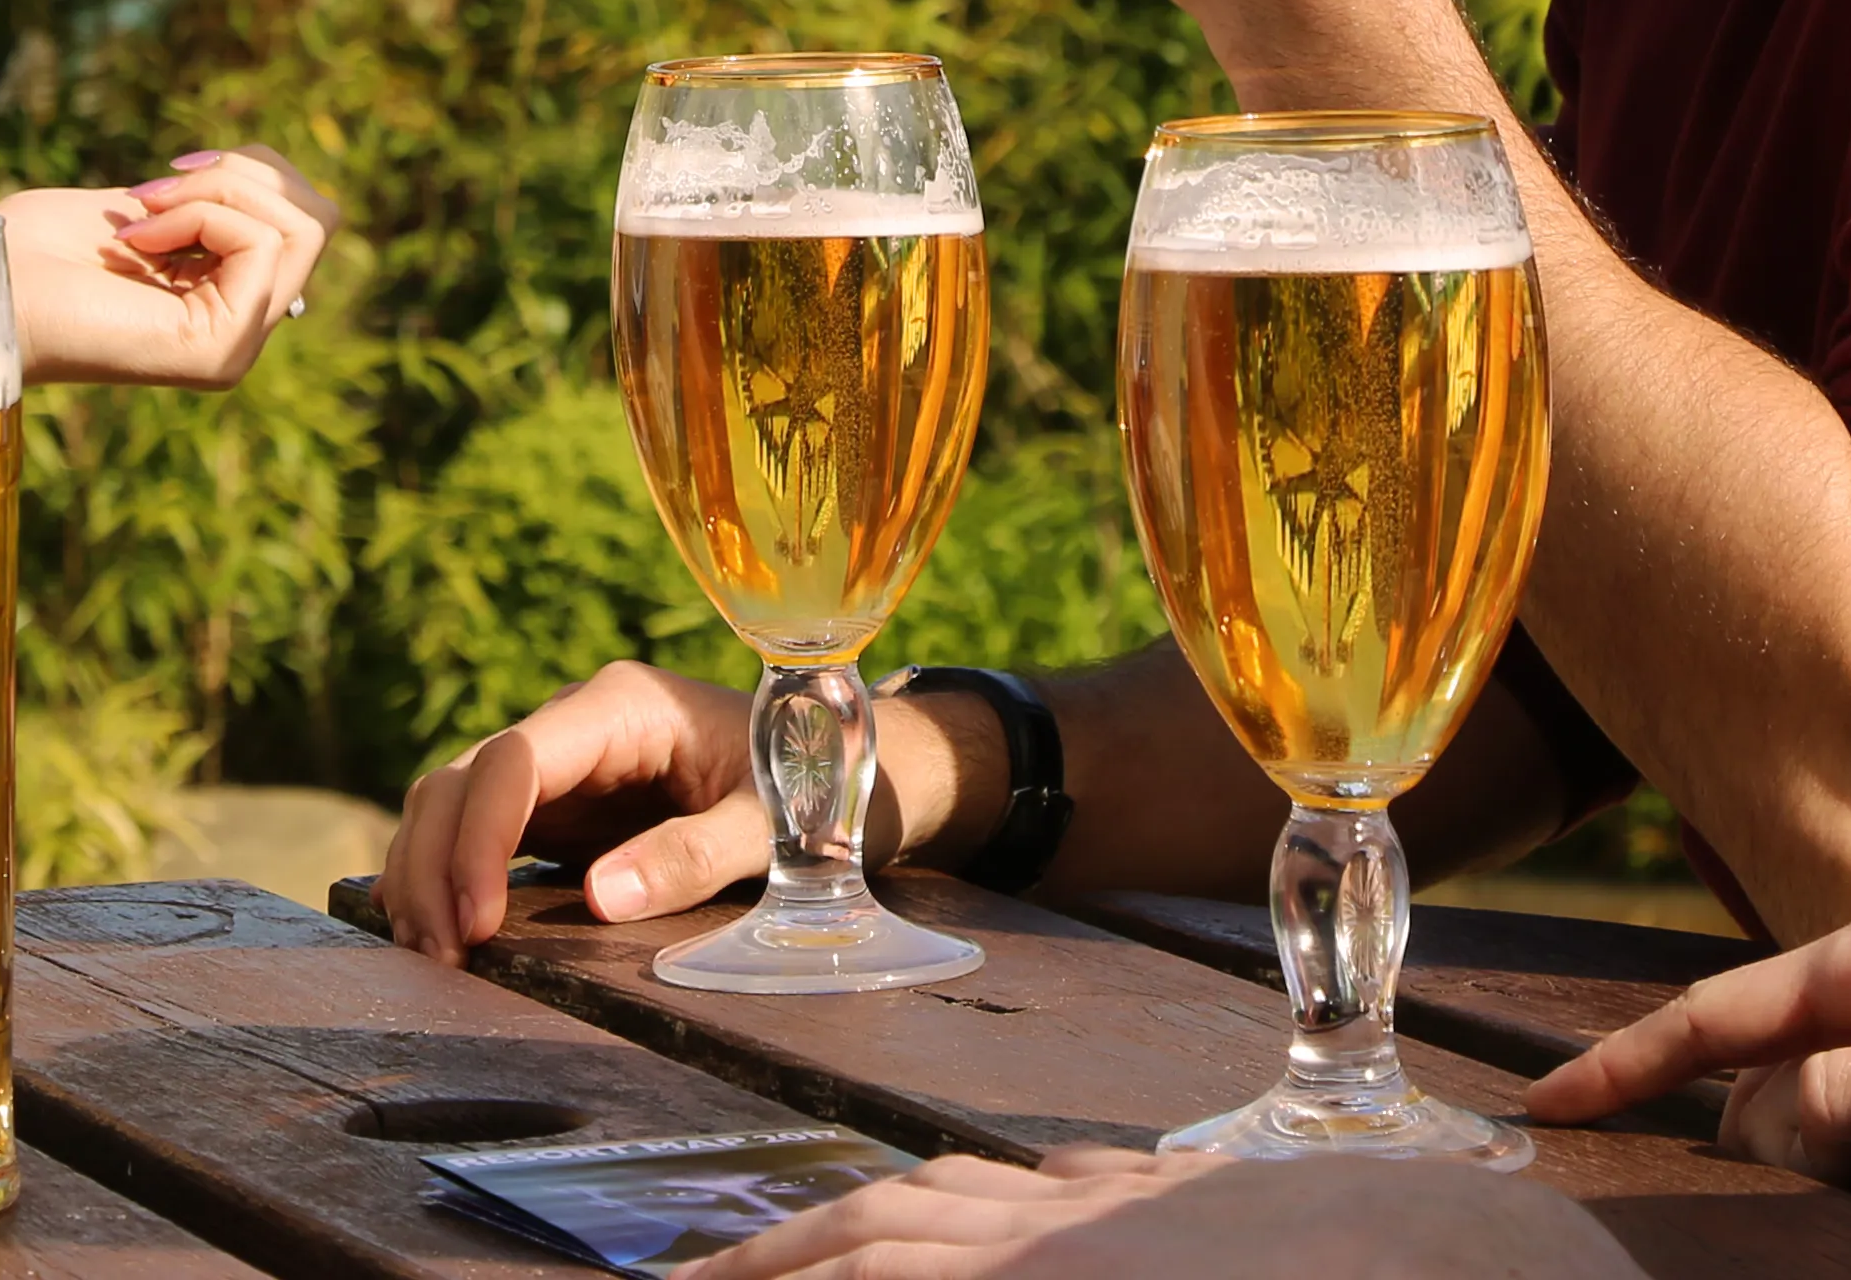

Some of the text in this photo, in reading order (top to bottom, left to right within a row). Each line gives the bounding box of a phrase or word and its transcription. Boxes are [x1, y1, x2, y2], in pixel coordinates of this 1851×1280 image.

[446, 1129, 838, 1168] RESORT MAP 2017
